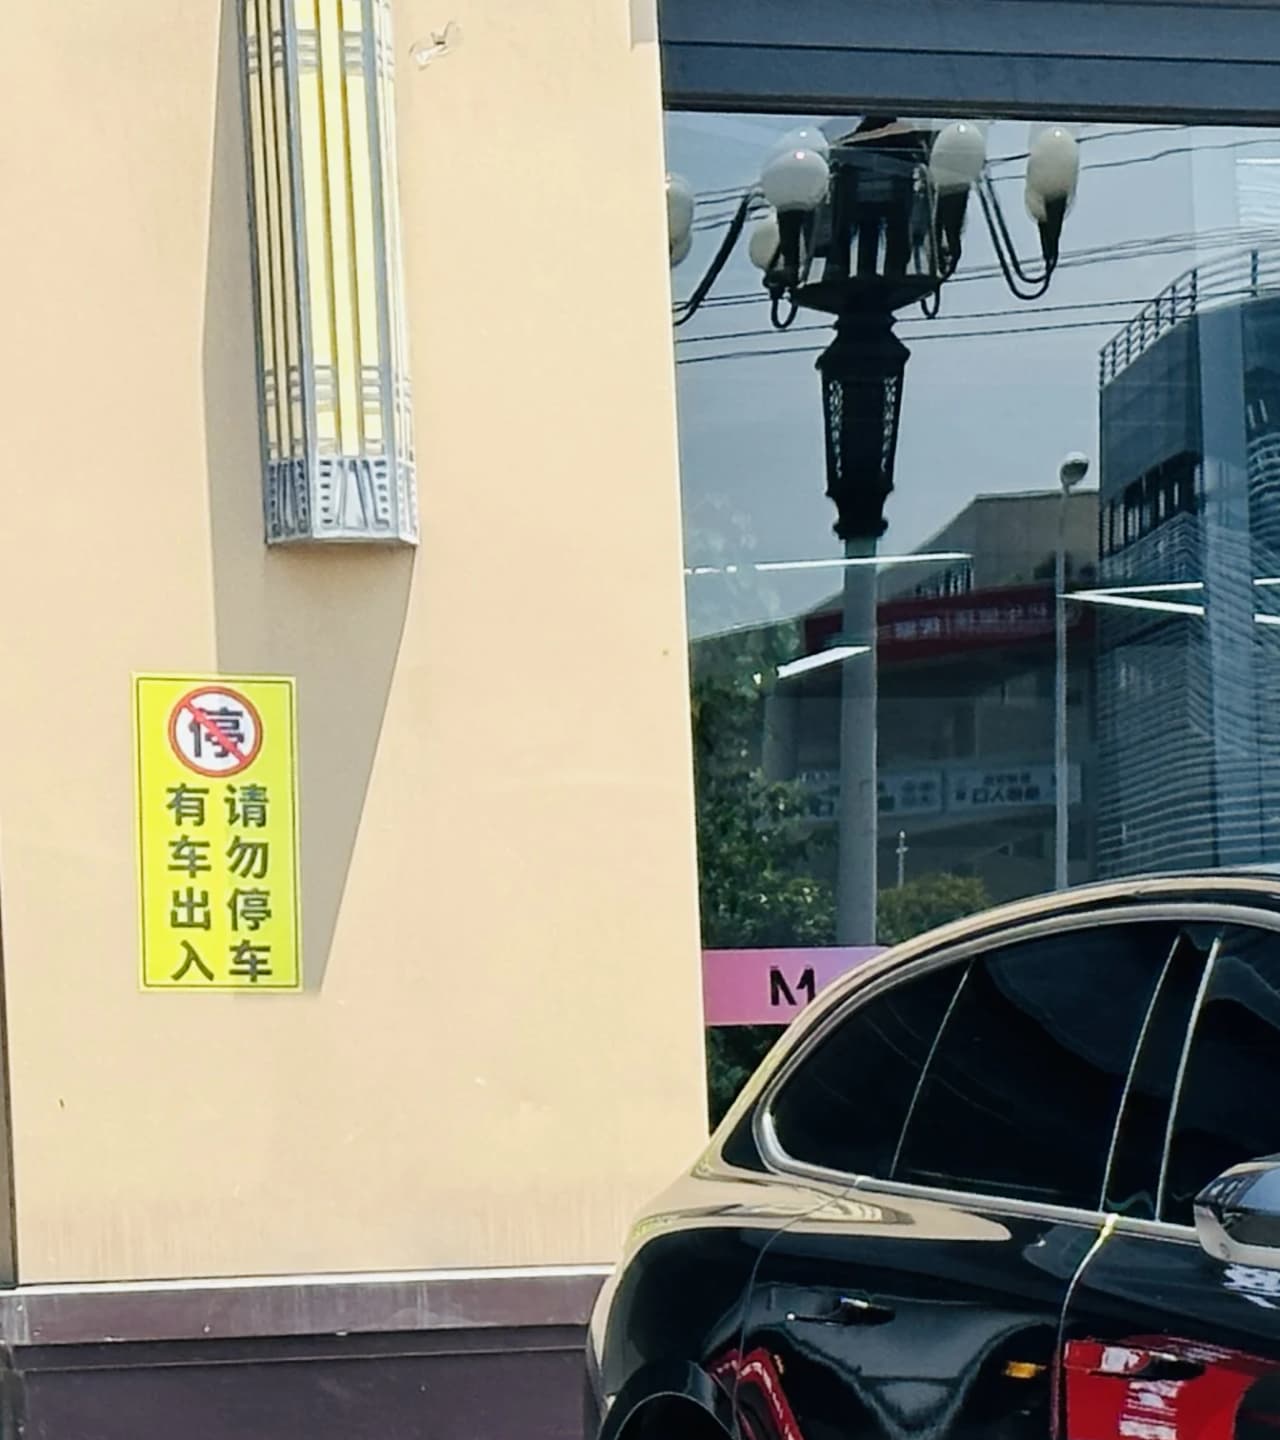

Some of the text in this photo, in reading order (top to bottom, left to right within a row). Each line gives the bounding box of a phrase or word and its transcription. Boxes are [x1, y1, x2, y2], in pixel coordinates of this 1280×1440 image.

[166, 782, 215, 982] 有车出入
[224, 783, 273, 983] 请勿停车
[769, 966, 817, 1006] M
